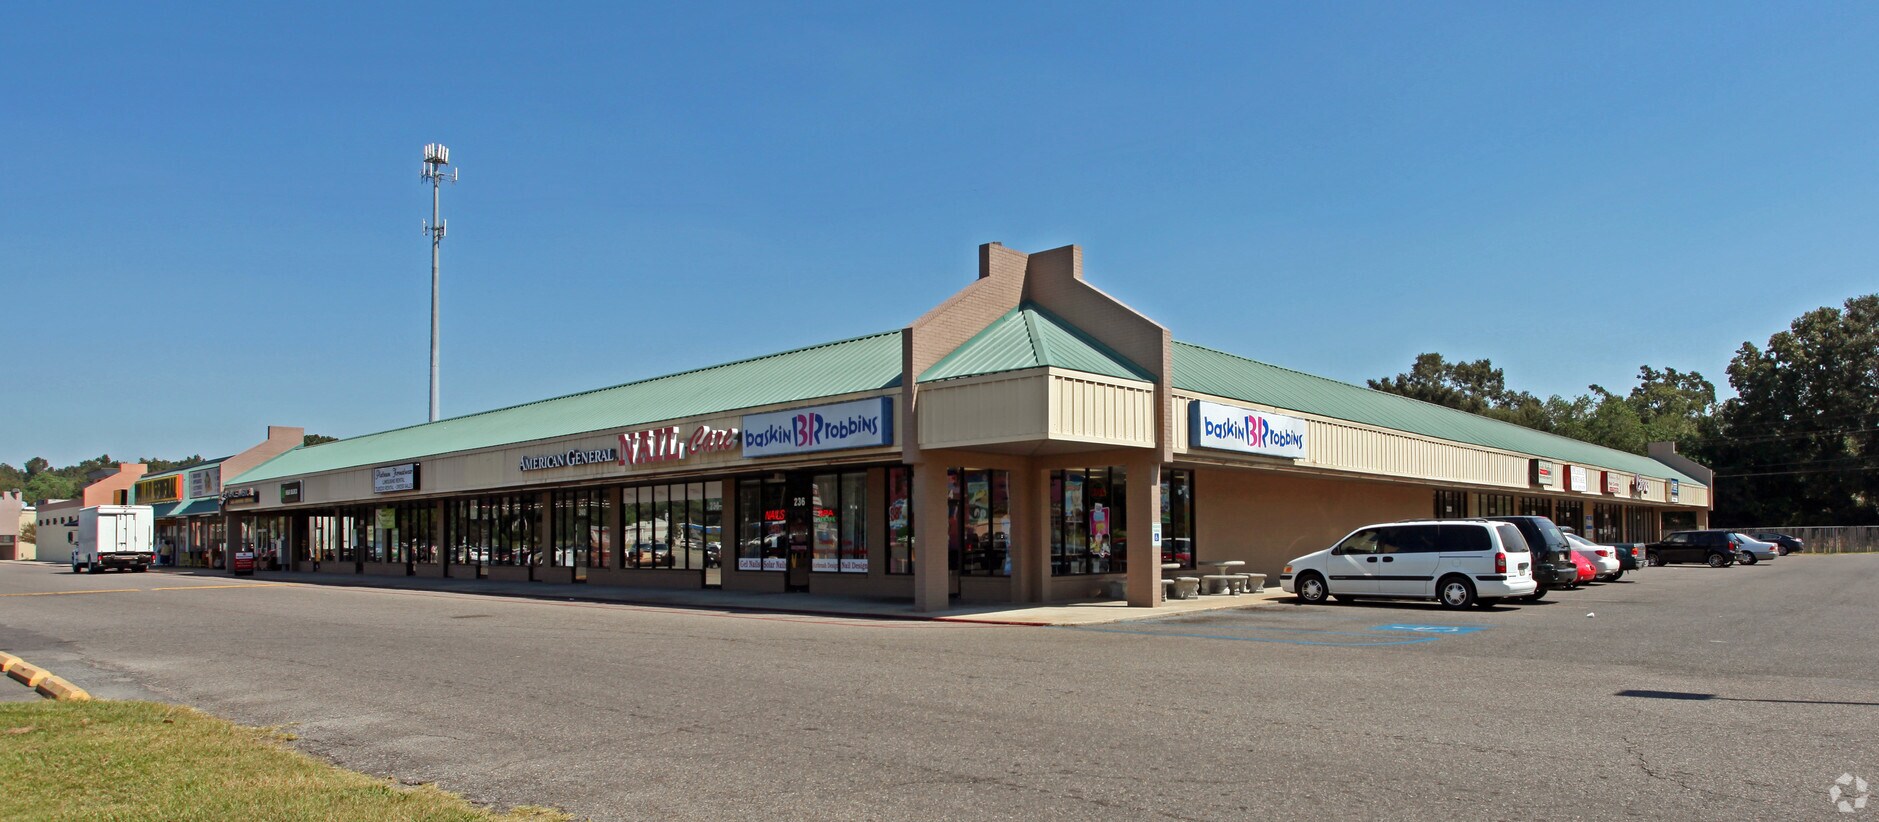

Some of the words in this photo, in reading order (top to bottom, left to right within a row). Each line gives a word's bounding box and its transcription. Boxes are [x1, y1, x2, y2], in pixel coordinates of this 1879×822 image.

[791, 412, 824, 447] BR
[1244, 414, 1269, 448] BR
[519, 454, 565, 471] AMERICAN
[566, 448, 614, 467] GENERAL
[618, 426, 684, 466] NAIL
[687, 425, 738, 455] Care
[765, 509, 785, 520] NAILS
[793, 497, 806, 507] 236
